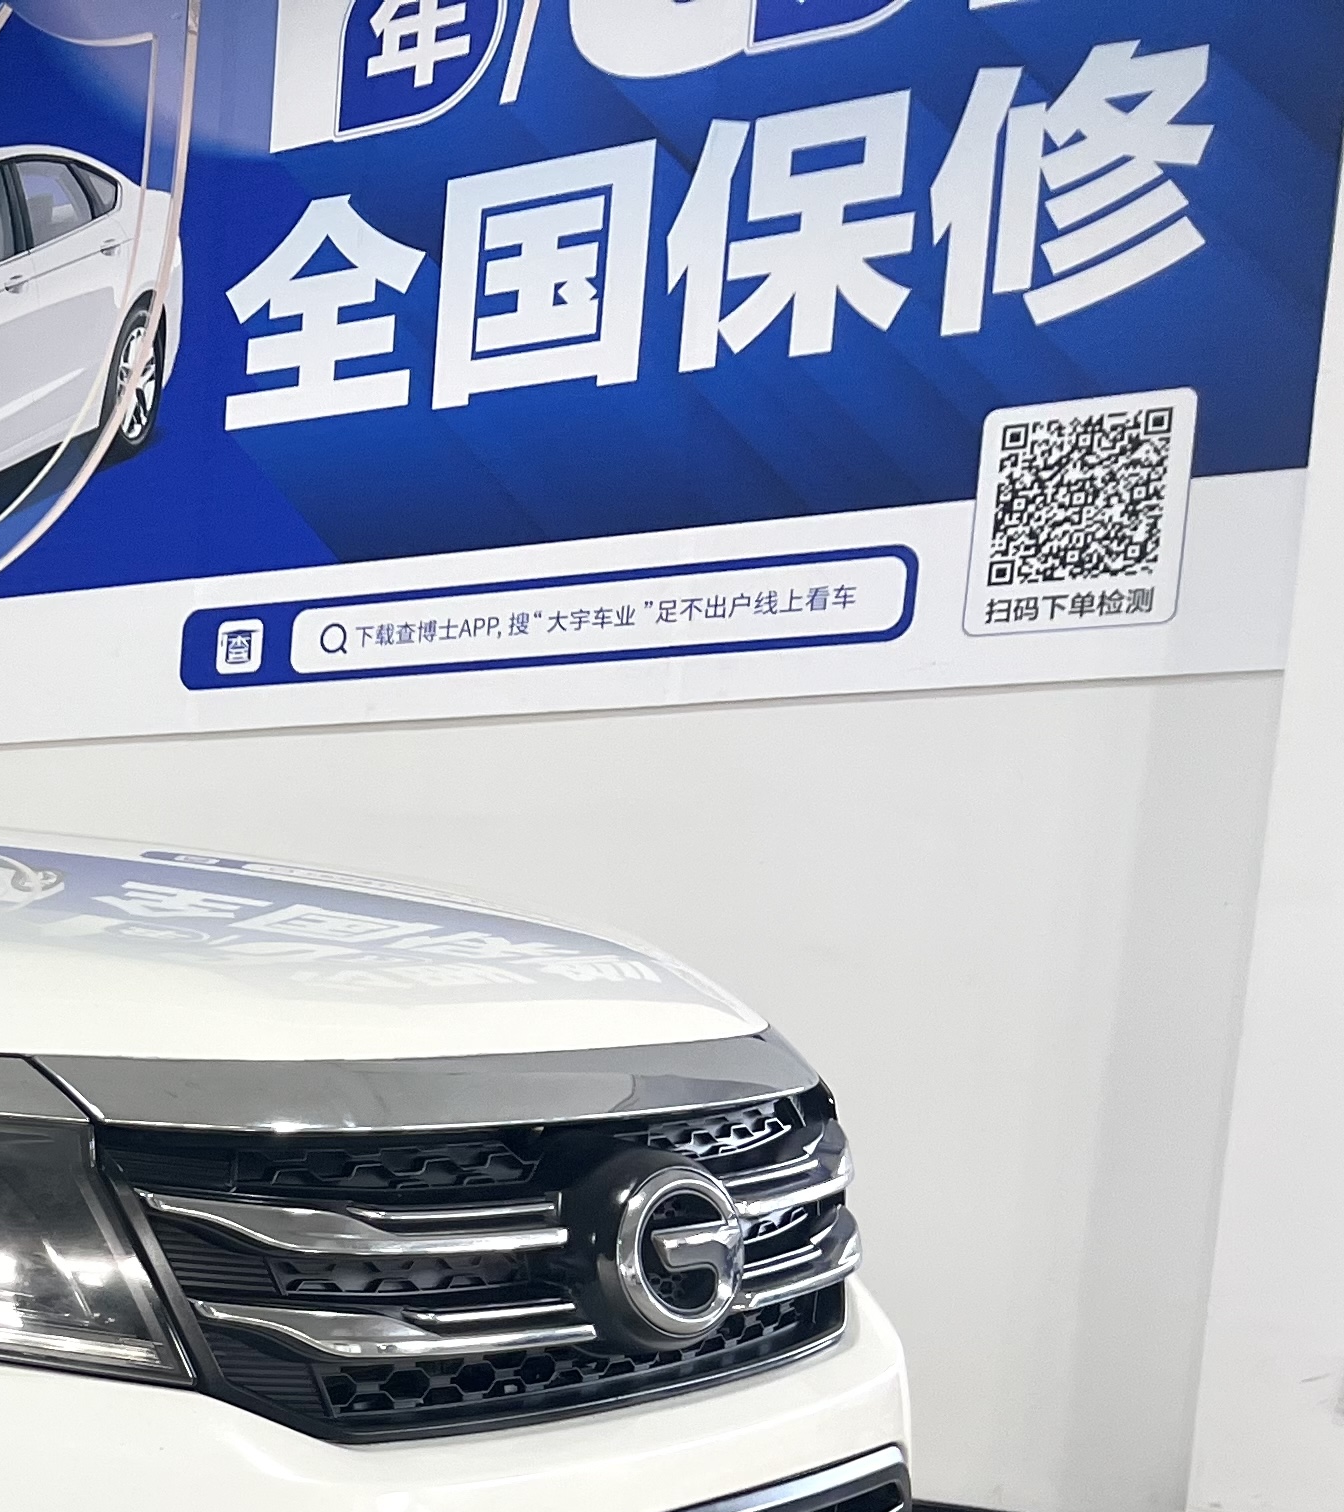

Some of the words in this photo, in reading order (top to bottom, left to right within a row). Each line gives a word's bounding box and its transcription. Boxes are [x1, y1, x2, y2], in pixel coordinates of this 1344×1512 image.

[224, 39, 1216, 431] 全国保修
[984, 586, 1155, 625] 扫码下单检测
